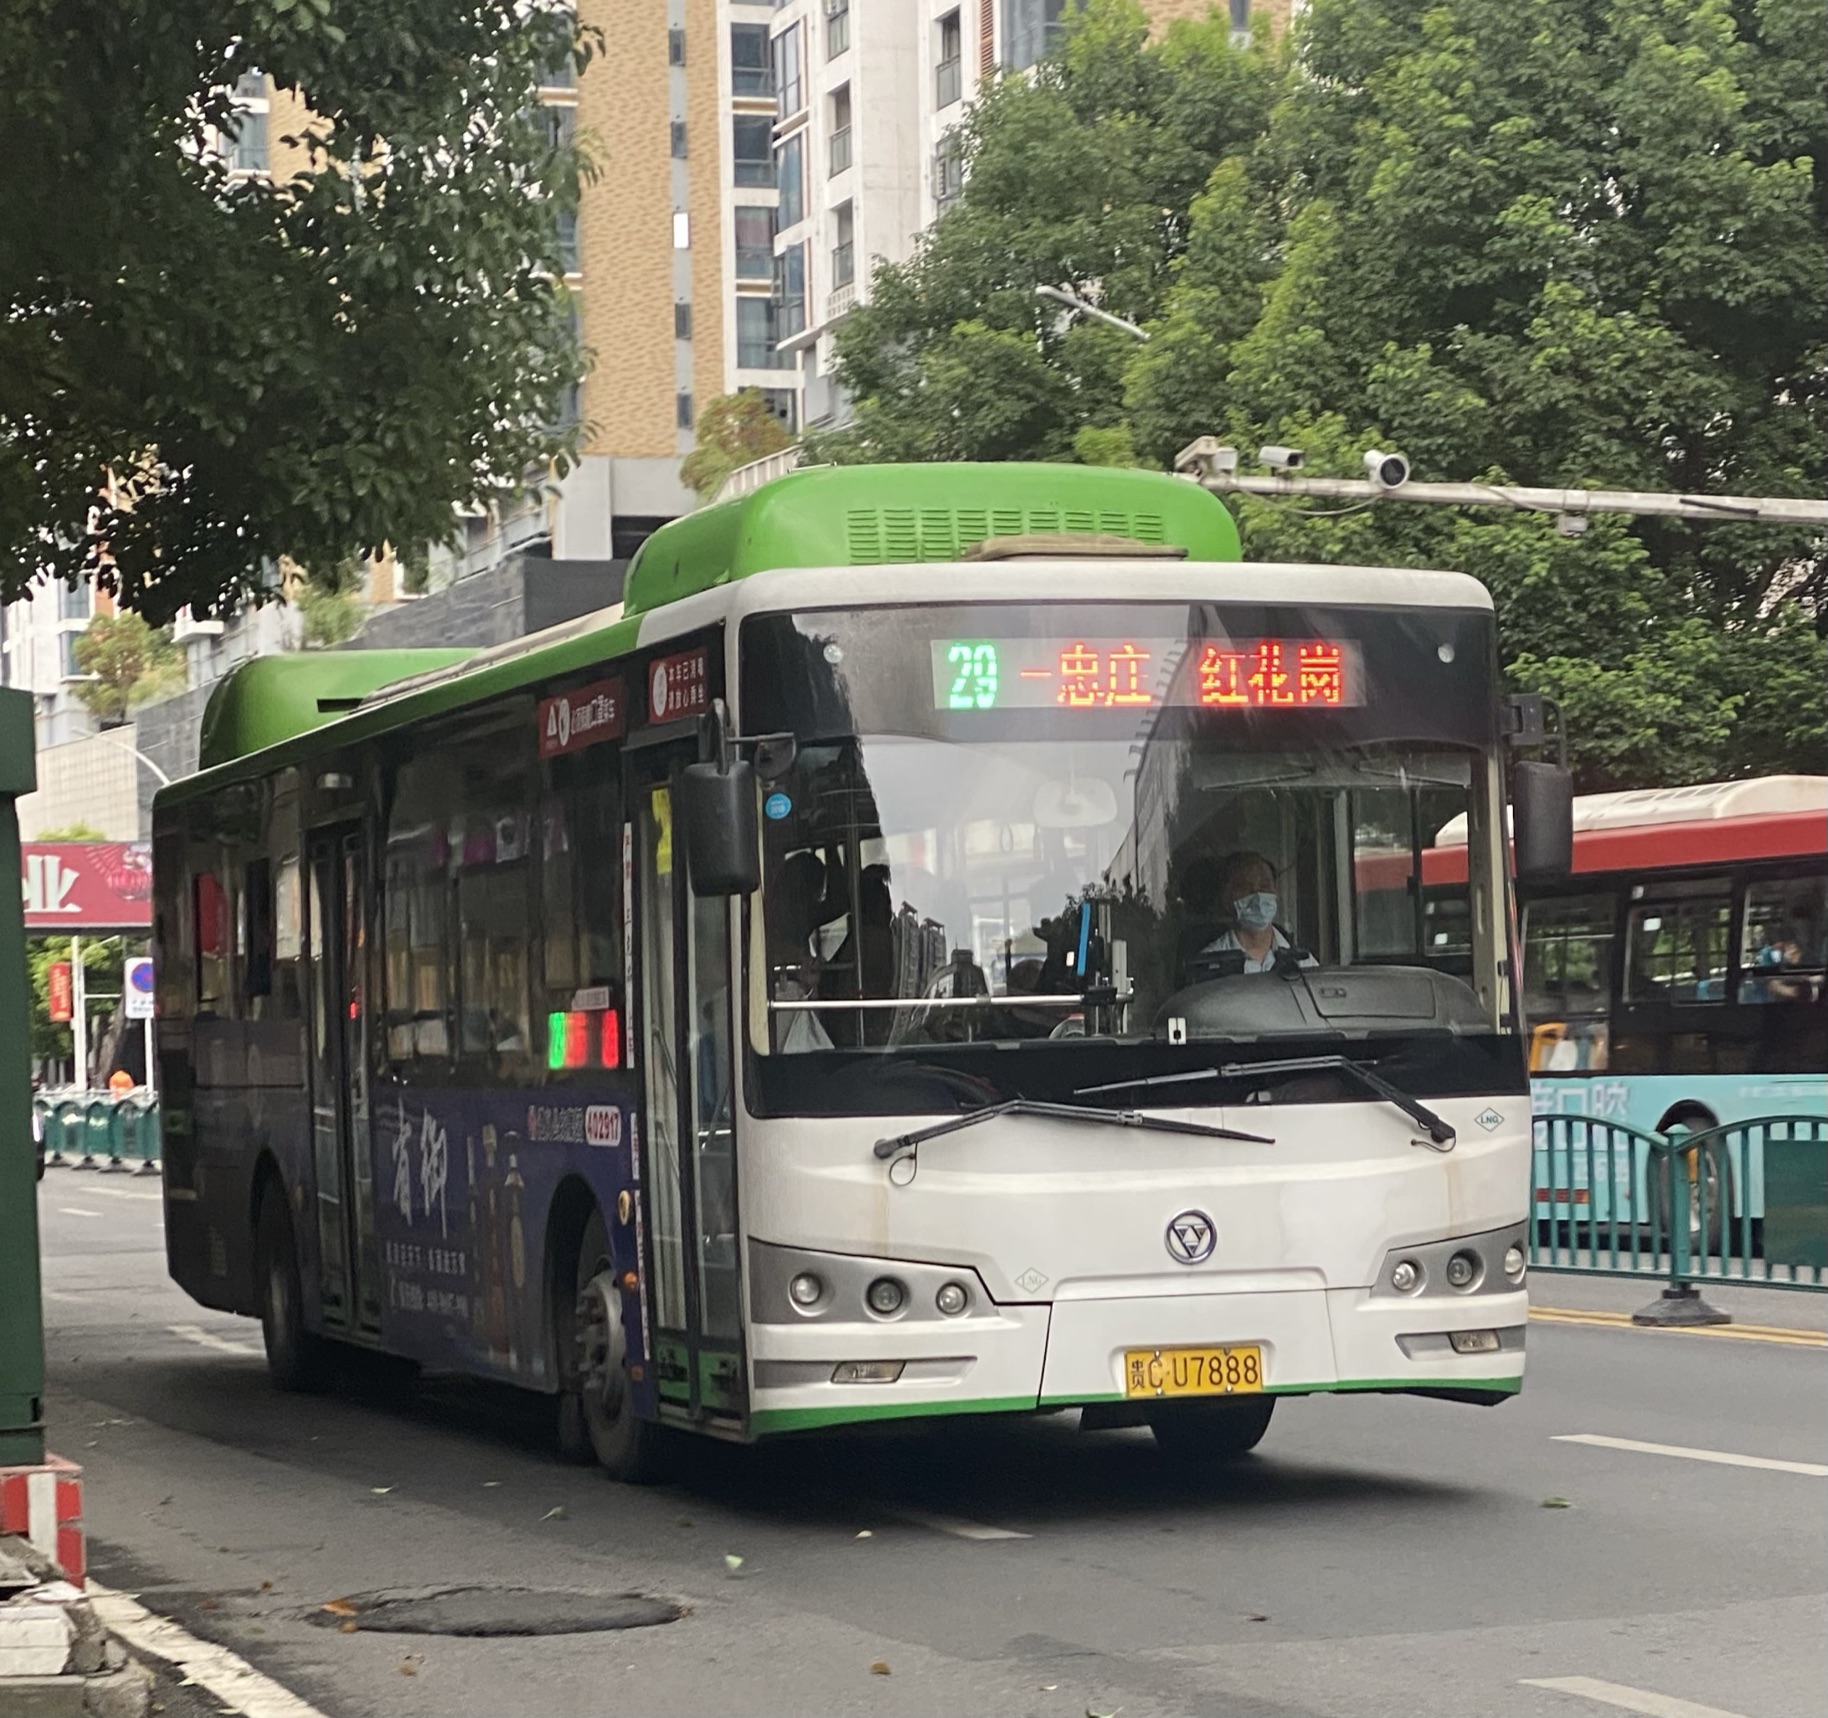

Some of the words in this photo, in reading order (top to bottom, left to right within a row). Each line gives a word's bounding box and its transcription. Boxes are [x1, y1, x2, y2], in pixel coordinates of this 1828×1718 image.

[947, 643, 998, 709] 29
[1200, 643, 1340, 705] 红花岗
[1480, 1115, 1500, 1124] LNG
